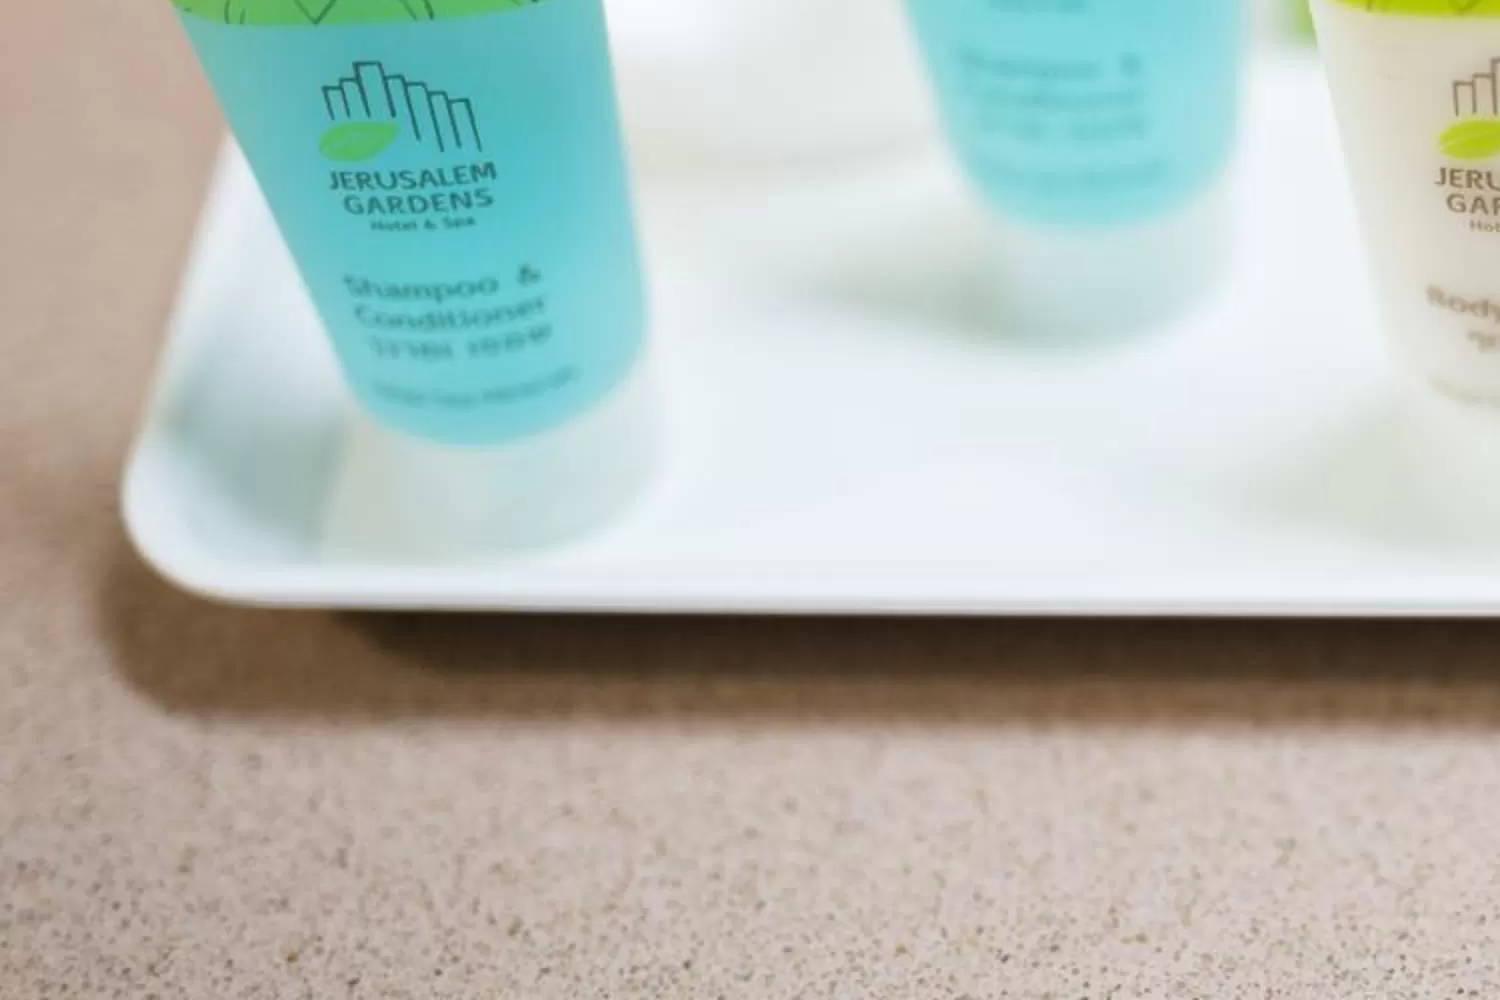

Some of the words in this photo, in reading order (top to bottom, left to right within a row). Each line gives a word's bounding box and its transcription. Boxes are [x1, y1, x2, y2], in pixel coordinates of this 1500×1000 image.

[329, 161, 497, 191] JERUSALEM
[344, 188, 495, 216] GARDENS
[342, 272, 500, 304] Shampoo
[516, 263, 543, 287] &
[353, 294, 546, 331] Conditioner
